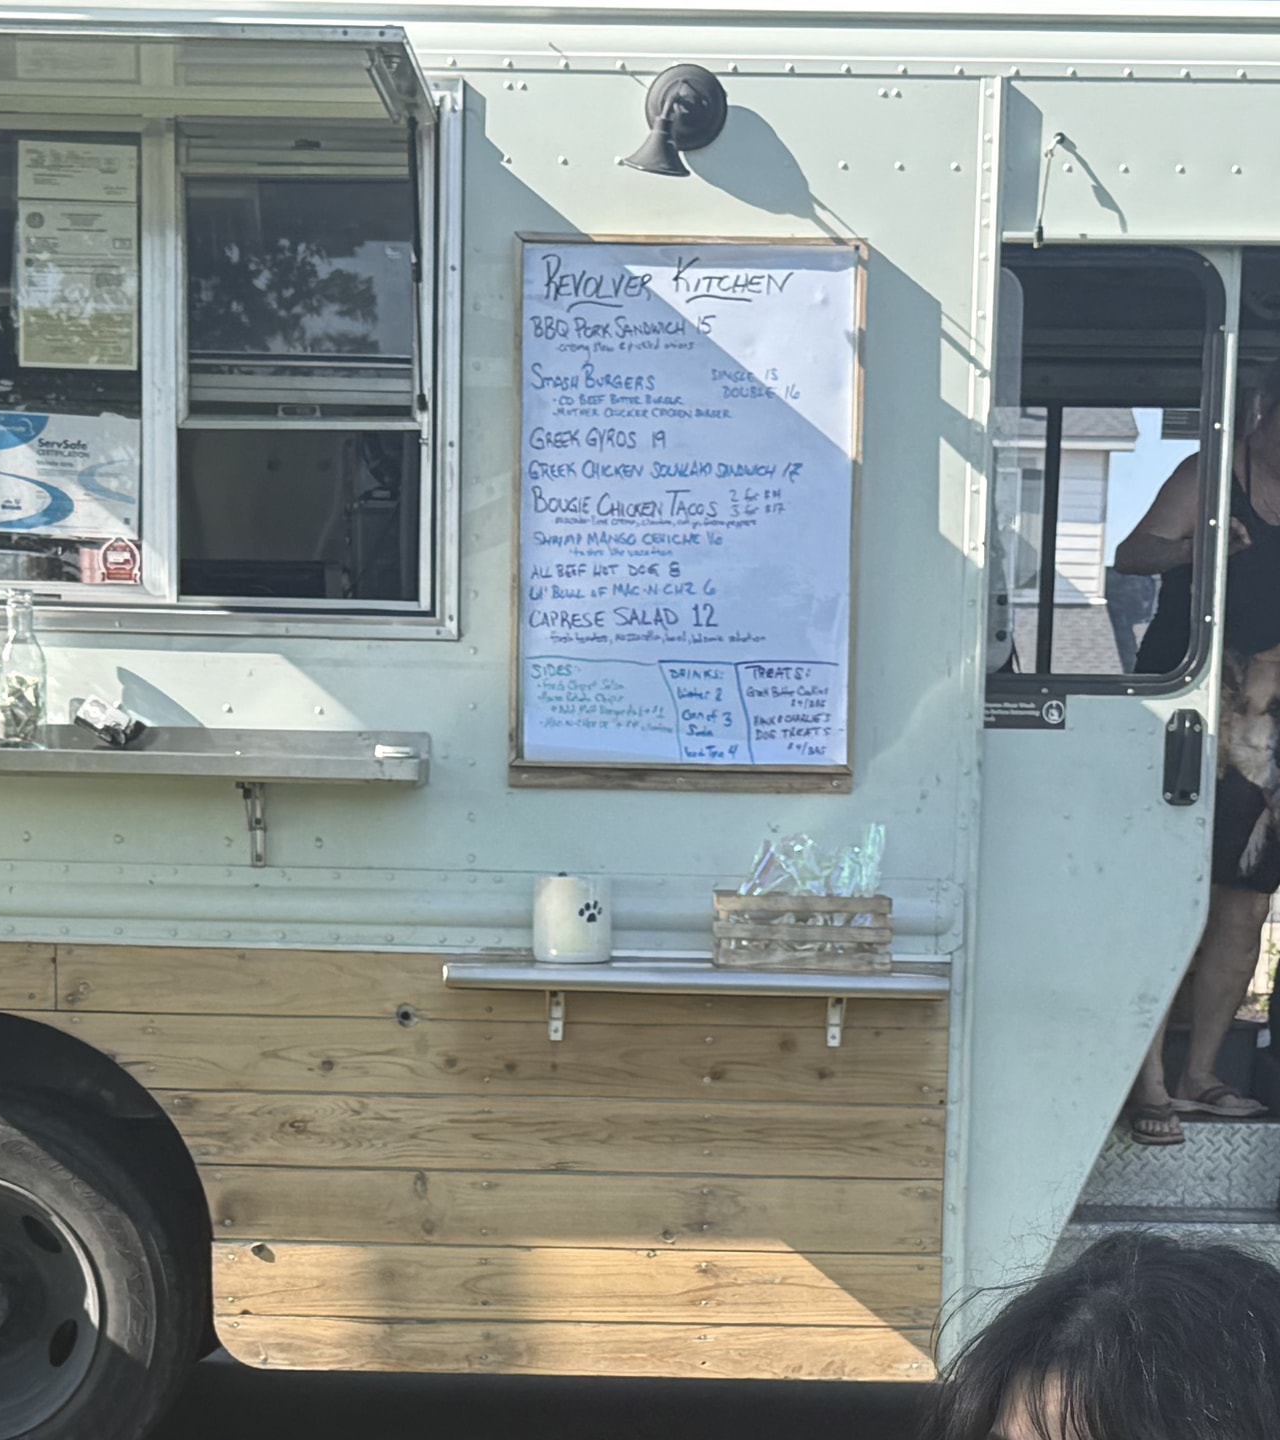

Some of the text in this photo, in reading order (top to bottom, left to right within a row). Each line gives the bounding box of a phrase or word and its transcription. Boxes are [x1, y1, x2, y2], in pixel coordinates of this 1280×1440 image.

[541, 253, 794, 302] REVOLVER KITCHEN
[530, 314, 717, 340] BBQ PORK SANDWICH 15
[530, 362, 656, 391] SMASH BURGERS
[722, 384, 777, 400] DOUBLE
[37, 437, 89, 451] ServSafe
[528, 426, 581, 451] GREEK
[585, 426, 638, 453] GYROS
[527, 459, 578, 481] GREEK
[581, 458, 644, 480] CHICKEN
[531, 484, 719, 518] BOUGIE CHICKEN TACOS
[728, 488, 740, 503] 2
[729, 503, 741, 518] 3
[530, 564, 553, 580] ALL
[555, 562, 587, 578] BEEF
[592, 563, 620, 578] HOT
[627, 562, 661, 578] DOG
[702, 578, 718, 597] 6
[528, 601, 720, 631] CAPRESE SALAD 12
[744, 664, 812, 681] TREATS:
